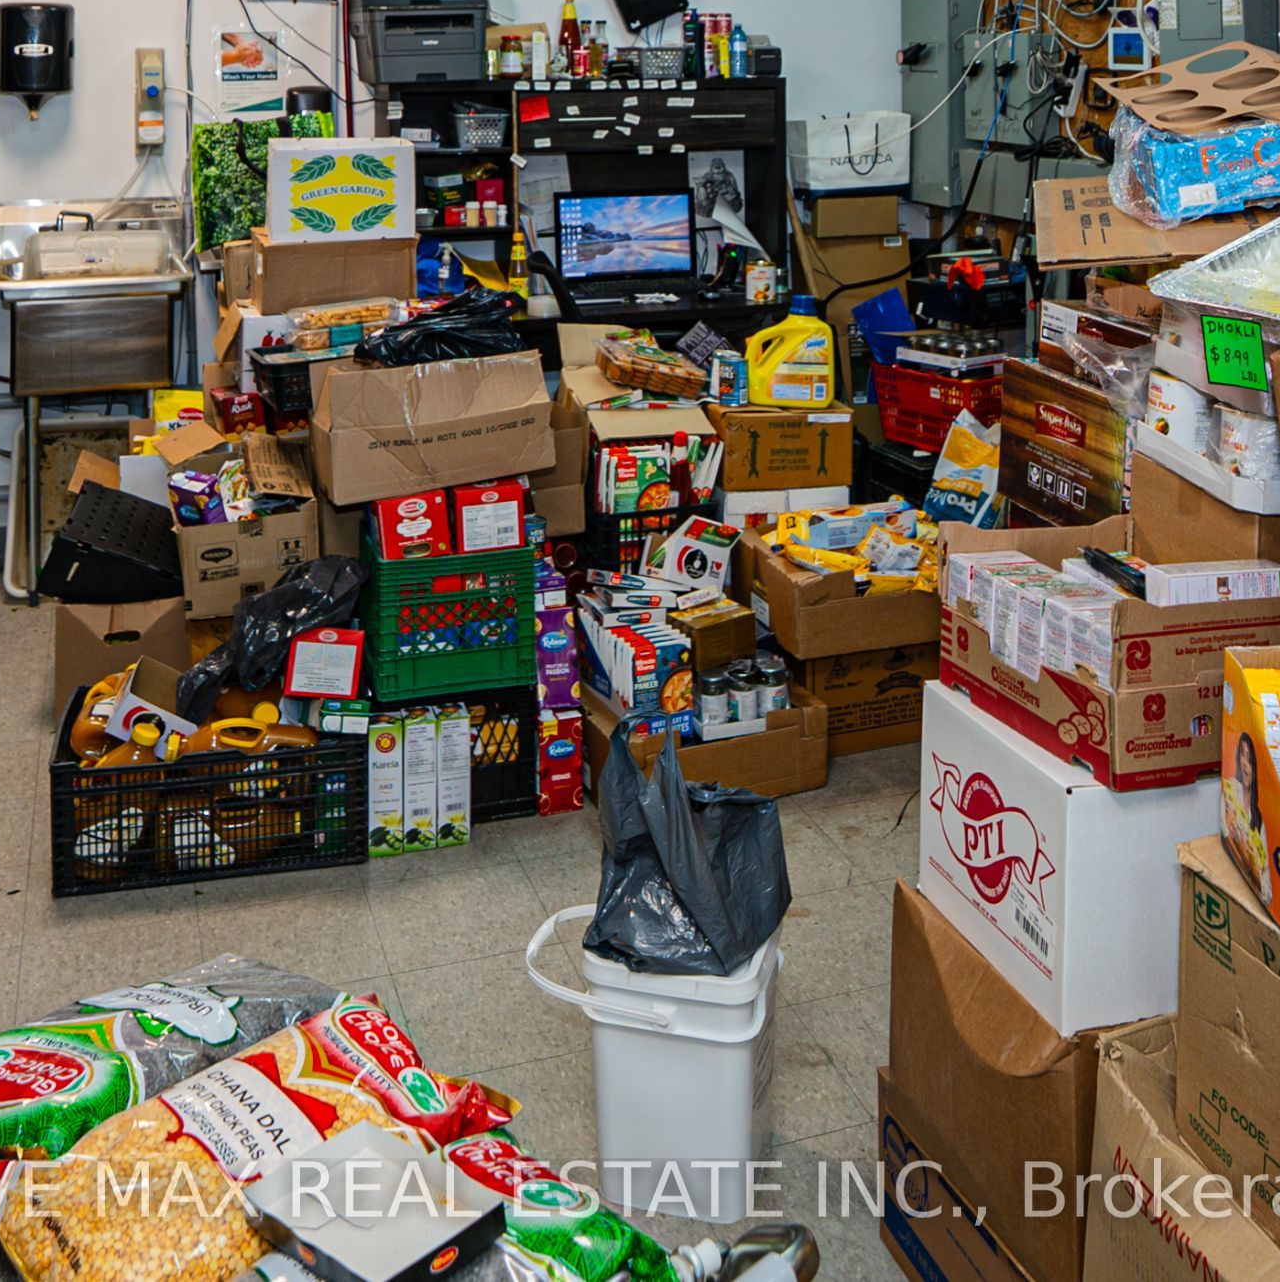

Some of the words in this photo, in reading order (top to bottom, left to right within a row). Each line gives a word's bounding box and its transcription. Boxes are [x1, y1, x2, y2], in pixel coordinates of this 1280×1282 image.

[830, 153, 894, 166] NAUTICA
[300, 187, 338, 203] GREEN
[340, 185, 386, 199] GARDEN
[1206, 320, 1256, 338] DHOKLA
[231, 401, 253, 414] Rusk
[1039, 405, 1066, 425] Super
[436, 432, 457, 443] ROTI
[1197, 686, 1210, 699] 12
[963, 818, 1006, 861] PTI
[187, 1082, 217, 1112] SPLIT
[209, 1099, 241, 1133] CHICK
[234, 1127, 265, 1161] PEAS
[207, 1070, 260, 1116] CHANA
[256, 1115, 289, 1155] DAL
[1211, 1088, 1228, 1113] FG
[1231, 1106, 1270, 1150] CODE:
